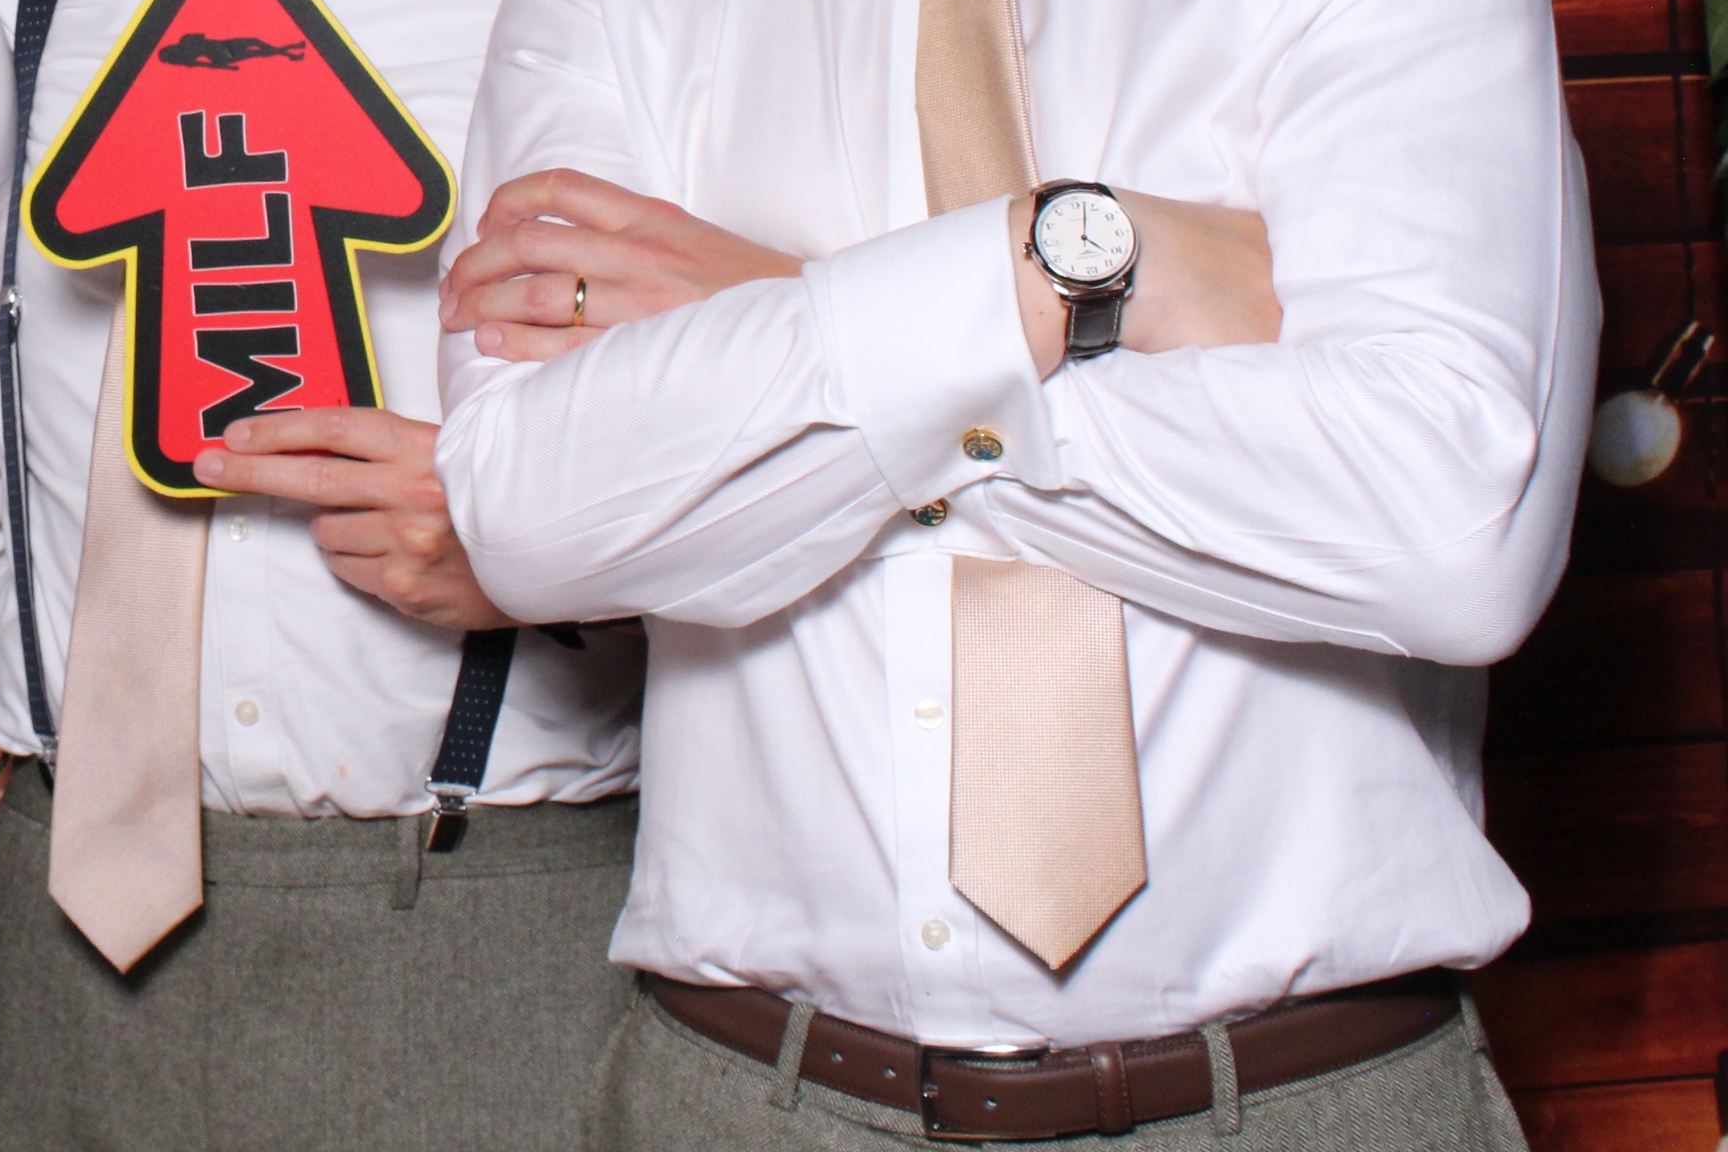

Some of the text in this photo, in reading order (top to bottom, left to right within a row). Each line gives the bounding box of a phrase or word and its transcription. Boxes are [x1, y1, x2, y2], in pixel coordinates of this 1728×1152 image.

[1071, 201, 1080, 210] 6
[1090, 203, 1098, 212] 7
[1054, 208, 1063, 216] 5
[1105, 213, 1114, 222] 8
[1115, 228, 1124, 237] 9
[1111, 246, 1122, 255] 10
[1104, 259, 1113, 267] 11
[1071, 265, 1075, 273] 1
[1086, 266, 1098, 275] 12
[178, 110, 303, 439] MILF
